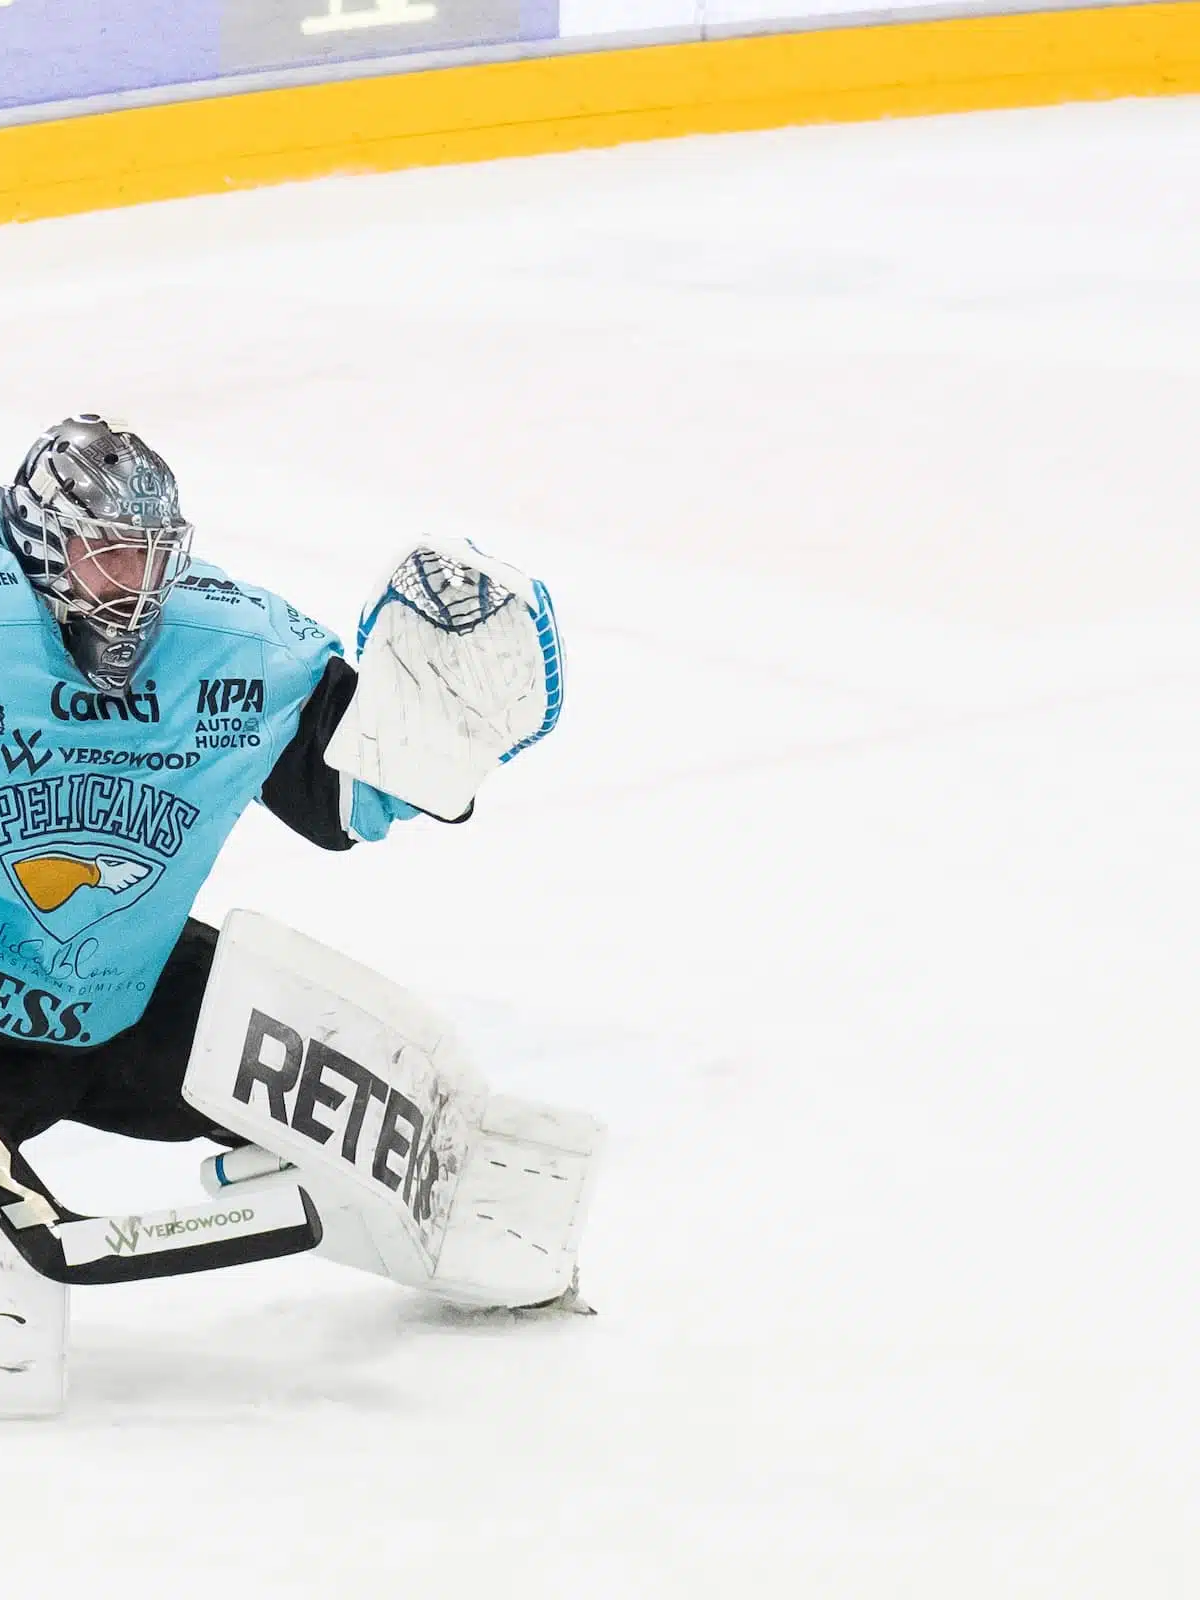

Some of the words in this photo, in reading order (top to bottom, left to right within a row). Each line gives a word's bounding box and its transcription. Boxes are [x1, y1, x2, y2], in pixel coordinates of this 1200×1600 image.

[196, 678, 265, 717] KPA
[195, 717, 242, 733] AUTO
[195, 734, 261, 749] HUOLTO
[58, 746, 201, 771] VERSOWOOD
[143, 1208, 255, 1239] VERSOWOOD
